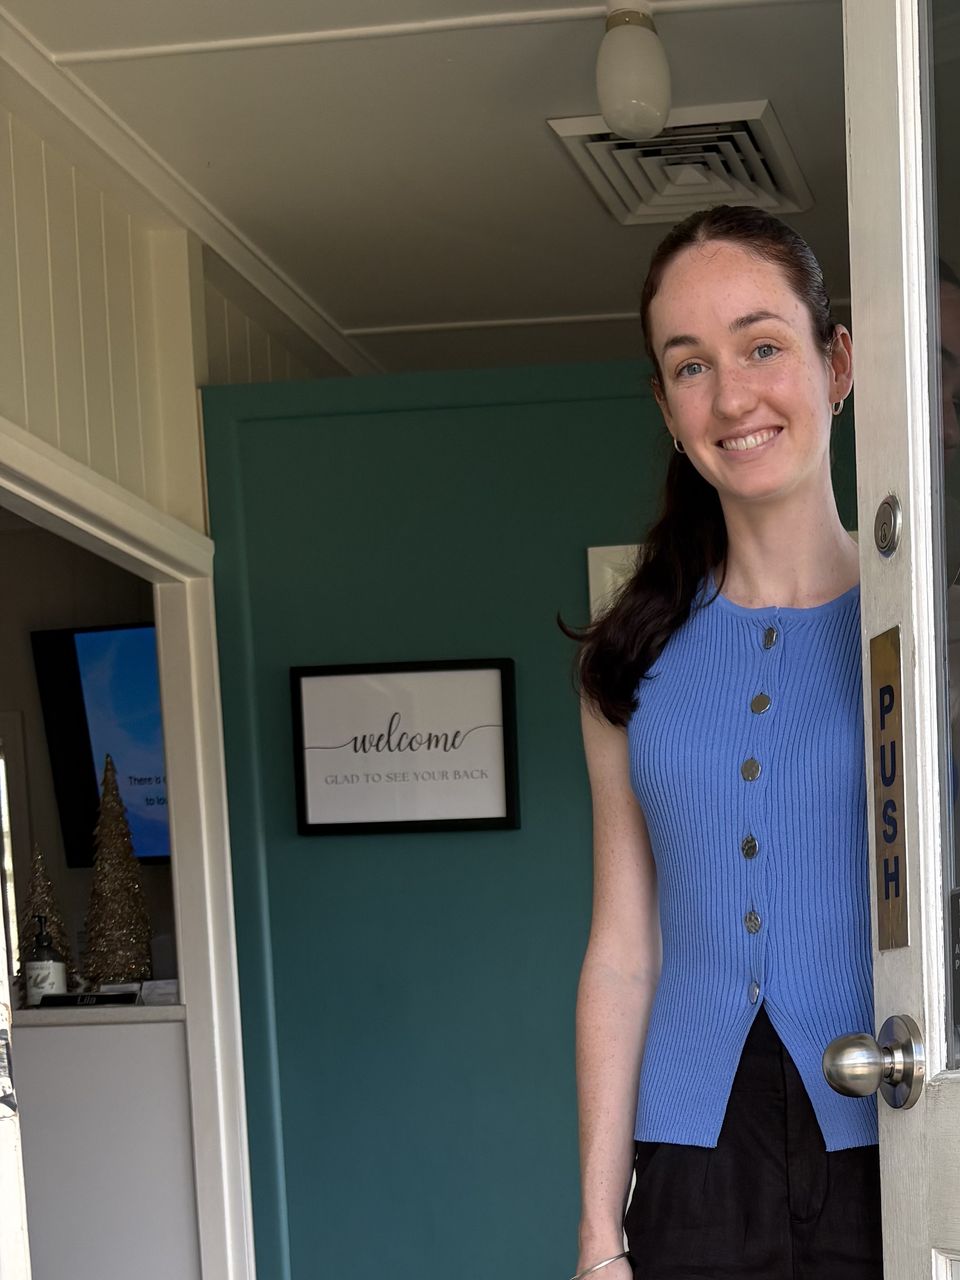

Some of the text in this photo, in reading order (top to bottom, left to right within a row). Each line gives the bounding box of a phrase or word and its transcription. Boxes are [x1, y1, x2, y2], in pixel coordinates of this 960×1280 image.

[345, 712, 468, 754] welcome
[324, 769, 489, 785] GLAD TO SEE YOUR BACK
[879, 684, 901, 900] PUSH
